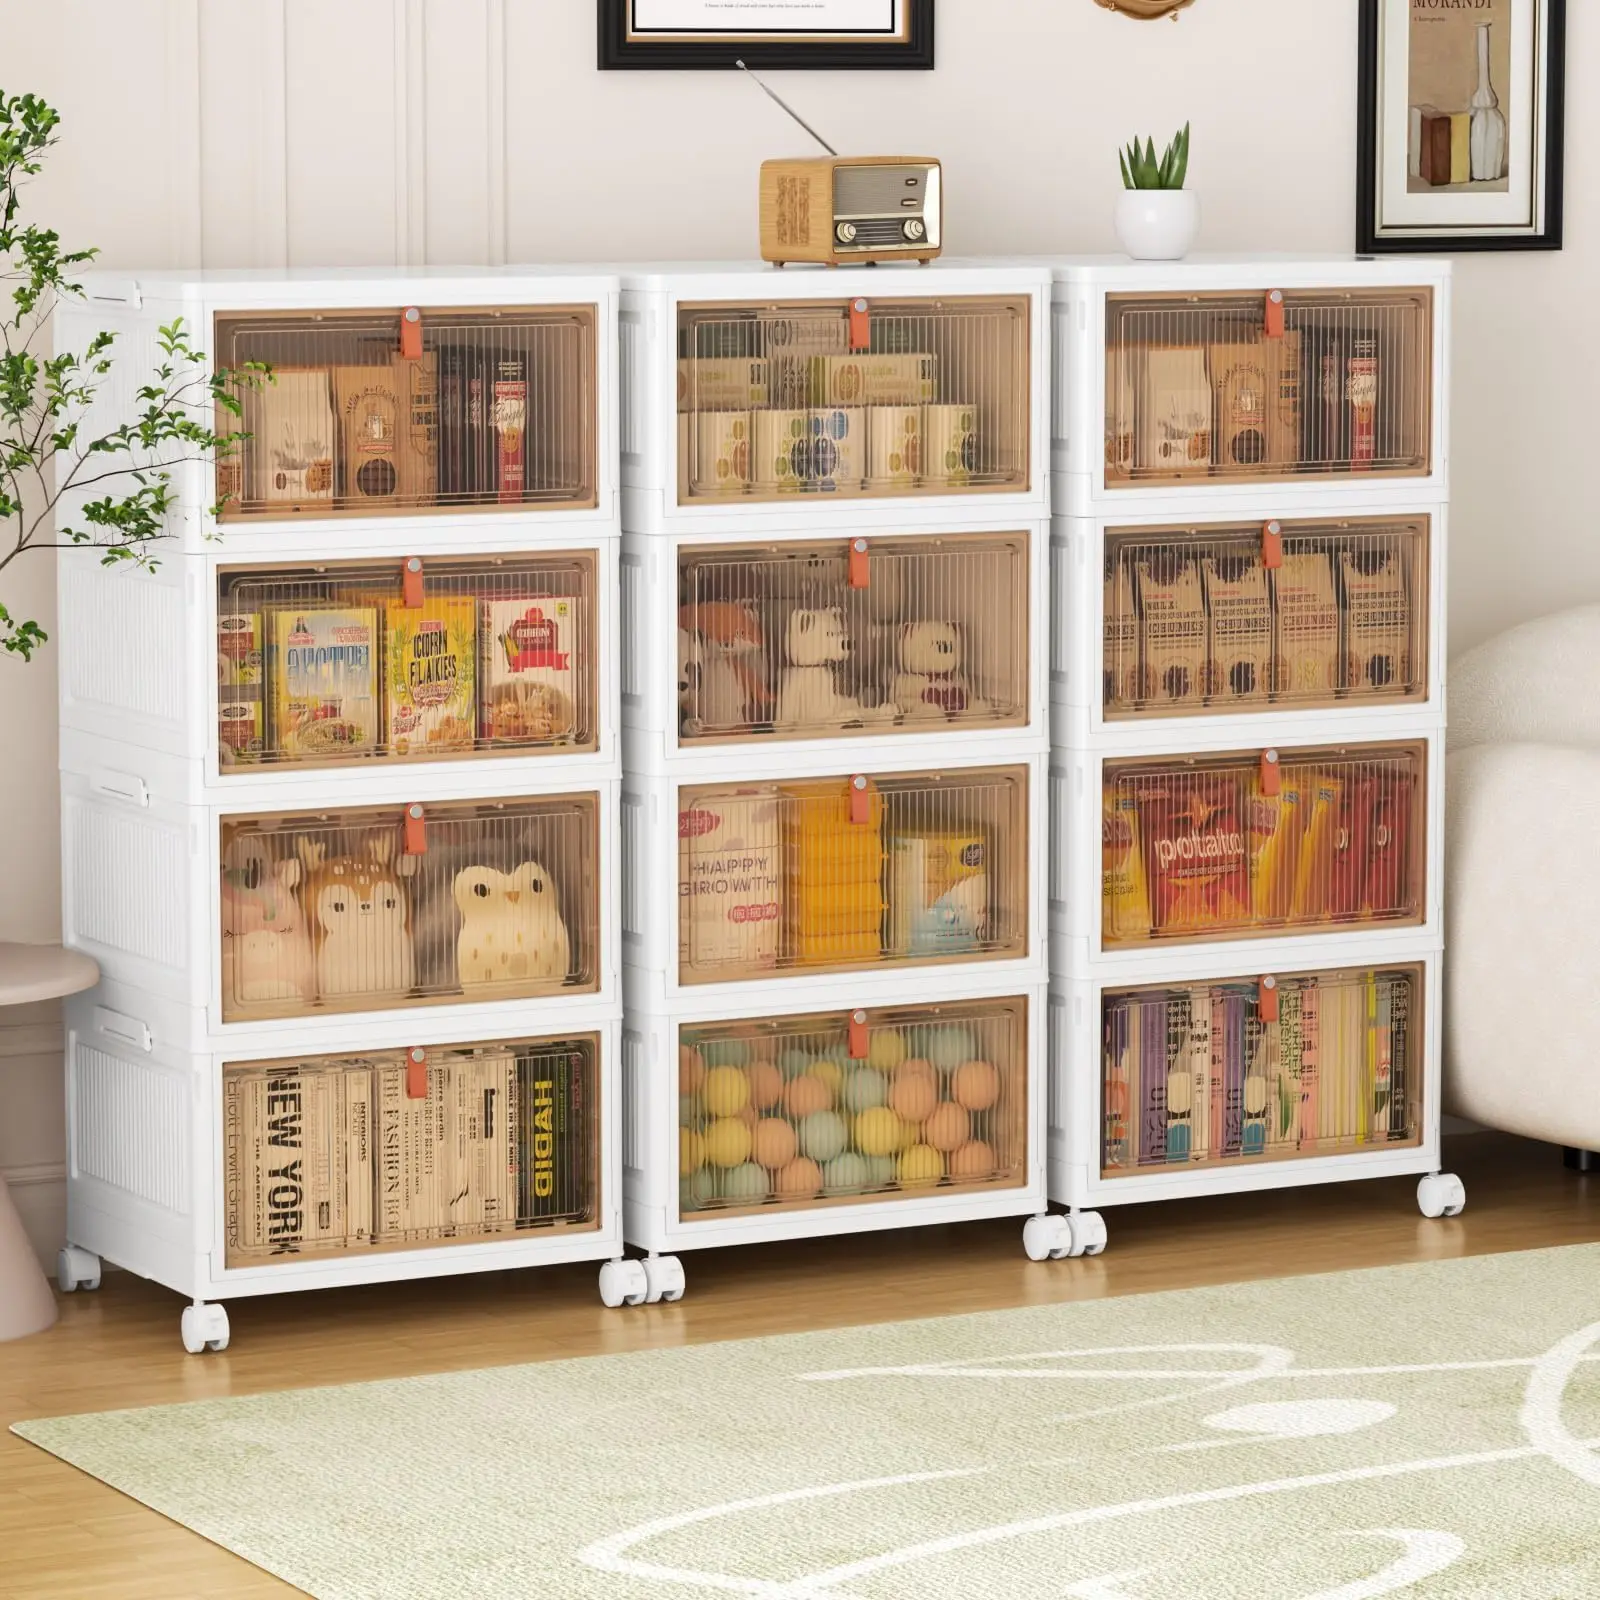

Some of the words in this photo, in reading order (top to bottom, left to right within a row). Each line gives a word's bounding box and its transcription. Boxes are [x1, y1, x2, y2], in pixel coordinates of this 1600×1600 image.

[1413, 0, 1492, 8] MORANDI
[693, 857, 769, 876] HAPPY
[266, 1066, 302, 1148] NEW
[434, 1069, 443, 1102] pierre
[508, 1111, 514, 1123] IN
[534, 1080, 553, 1197] HADID
[383, 1109, 399, 1193] FASHION
[268, 1160, 303, 1255] YORK
